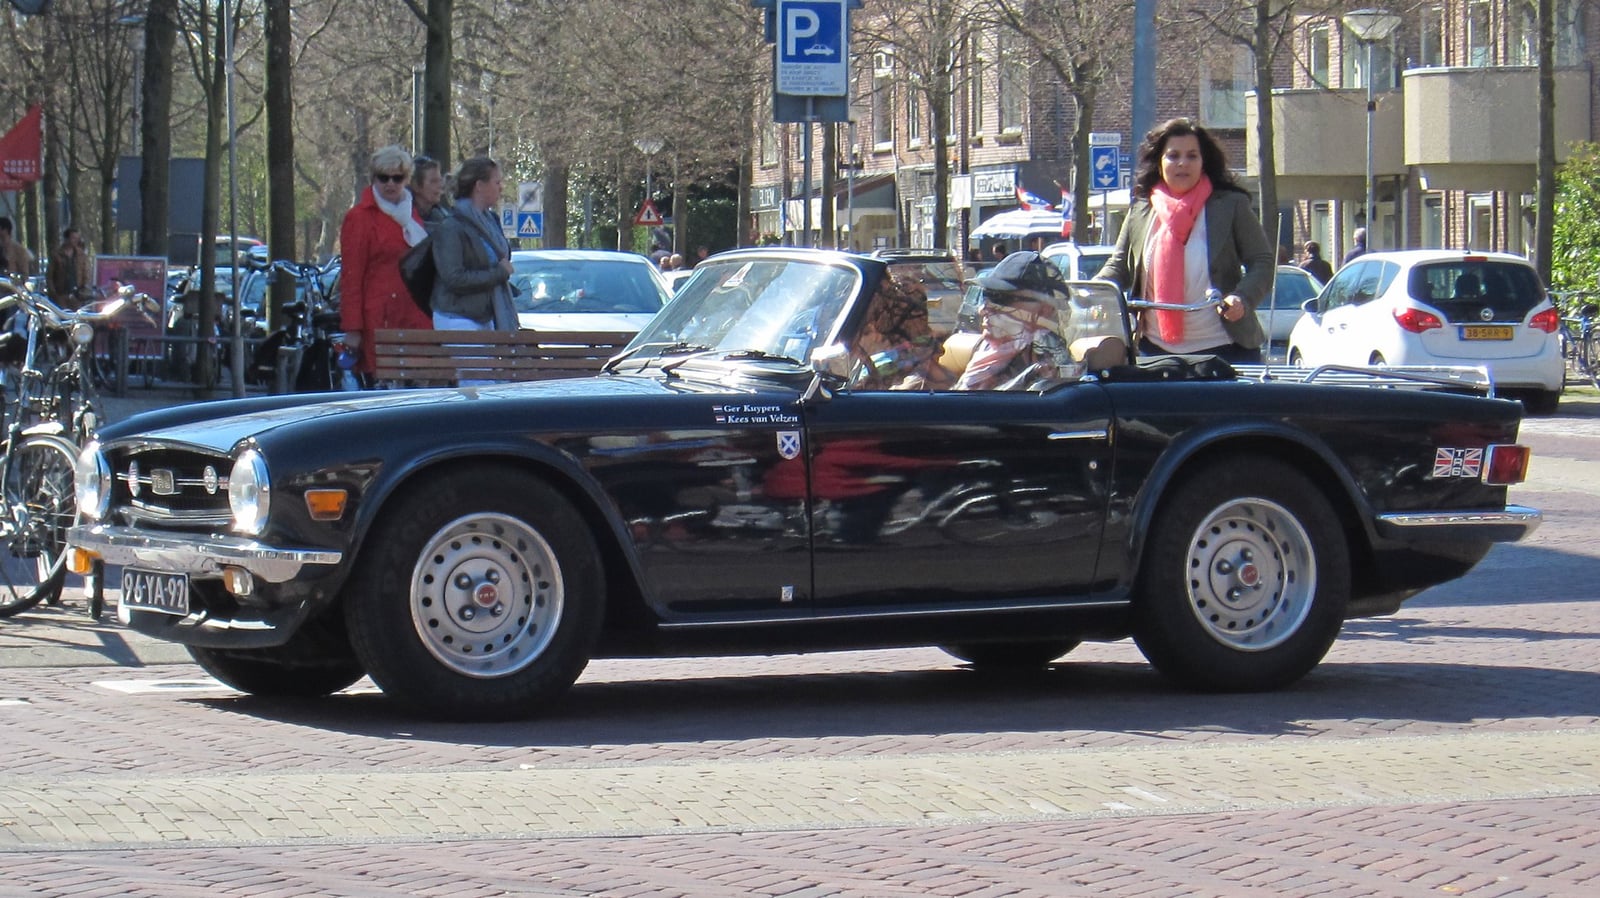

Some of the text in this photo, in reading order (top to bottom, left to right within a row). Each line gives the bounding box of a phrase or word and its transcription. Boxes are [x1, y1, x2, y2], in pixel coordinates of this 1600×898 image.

[787, 8, 820, 56] P
[723, 404, 780, 414] Ger Kuypers
[727, 415, 749, 424] Kees
[770, 413, 798, 423] Velzen
[1451, 449, 1465, 476] TR6
[124, 573, 185, 608] 96-YA-92
